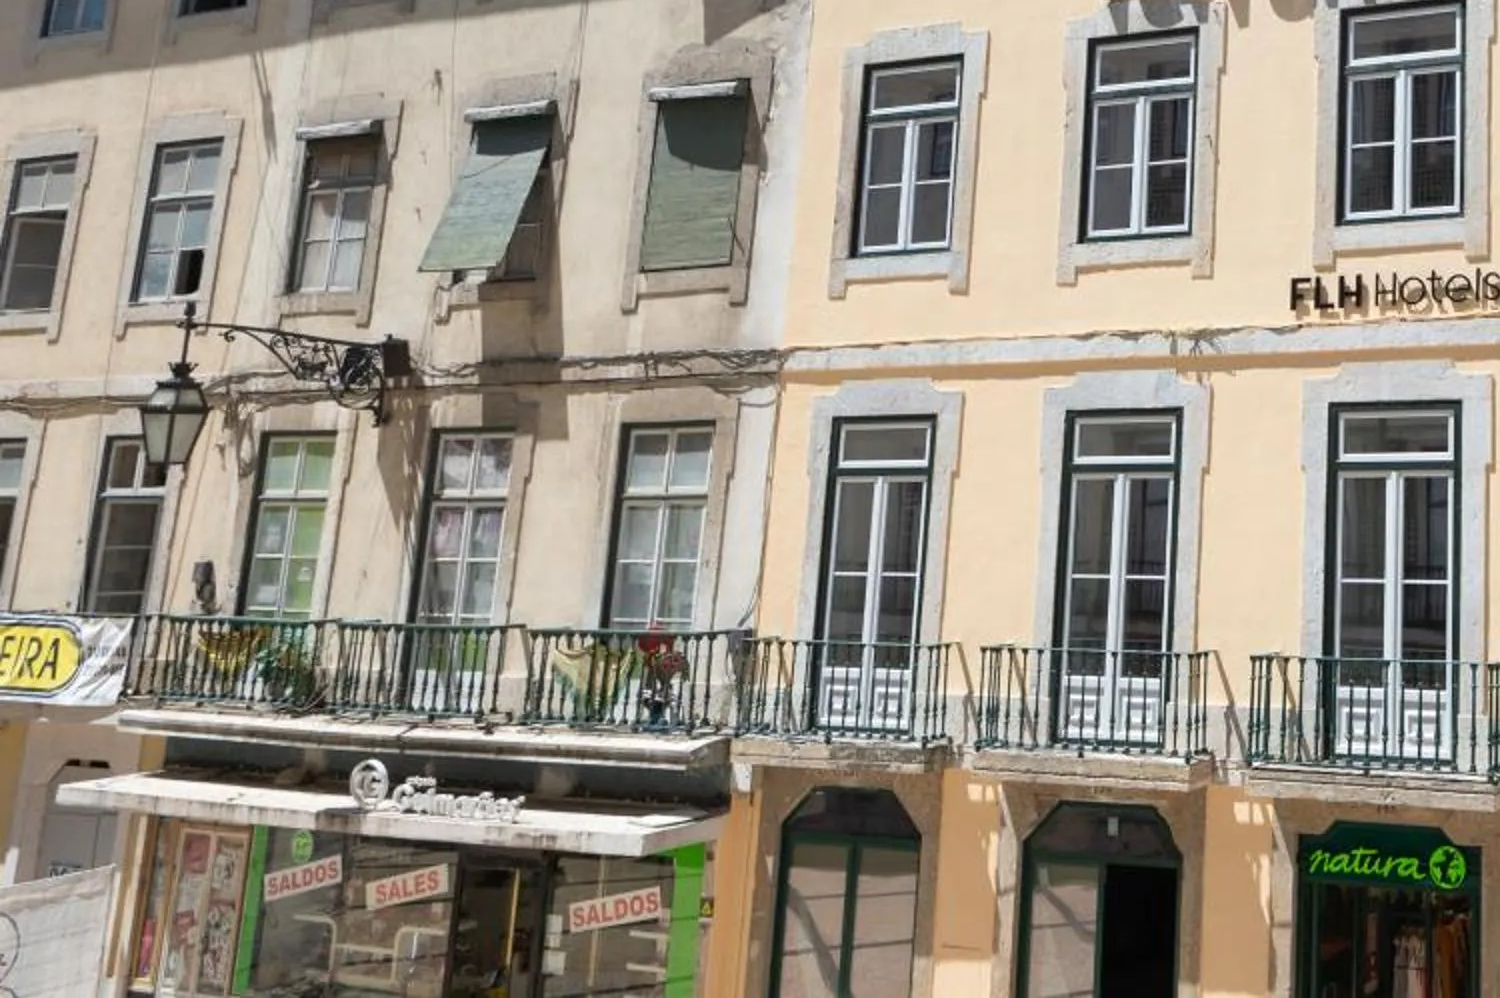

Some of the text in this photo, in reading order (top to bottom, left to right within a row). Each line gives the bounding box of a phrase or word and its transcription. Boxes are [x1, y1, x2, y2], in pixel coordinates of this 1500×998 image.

[1290, 267, 1500, 311] FLH Hotels
[267, 860, 338, 895] SALDOS
[1309, 846, 1427, 880] natura
[375, 870, 440, 903] SALES
[573, 892, 659, 927] SALDOS
